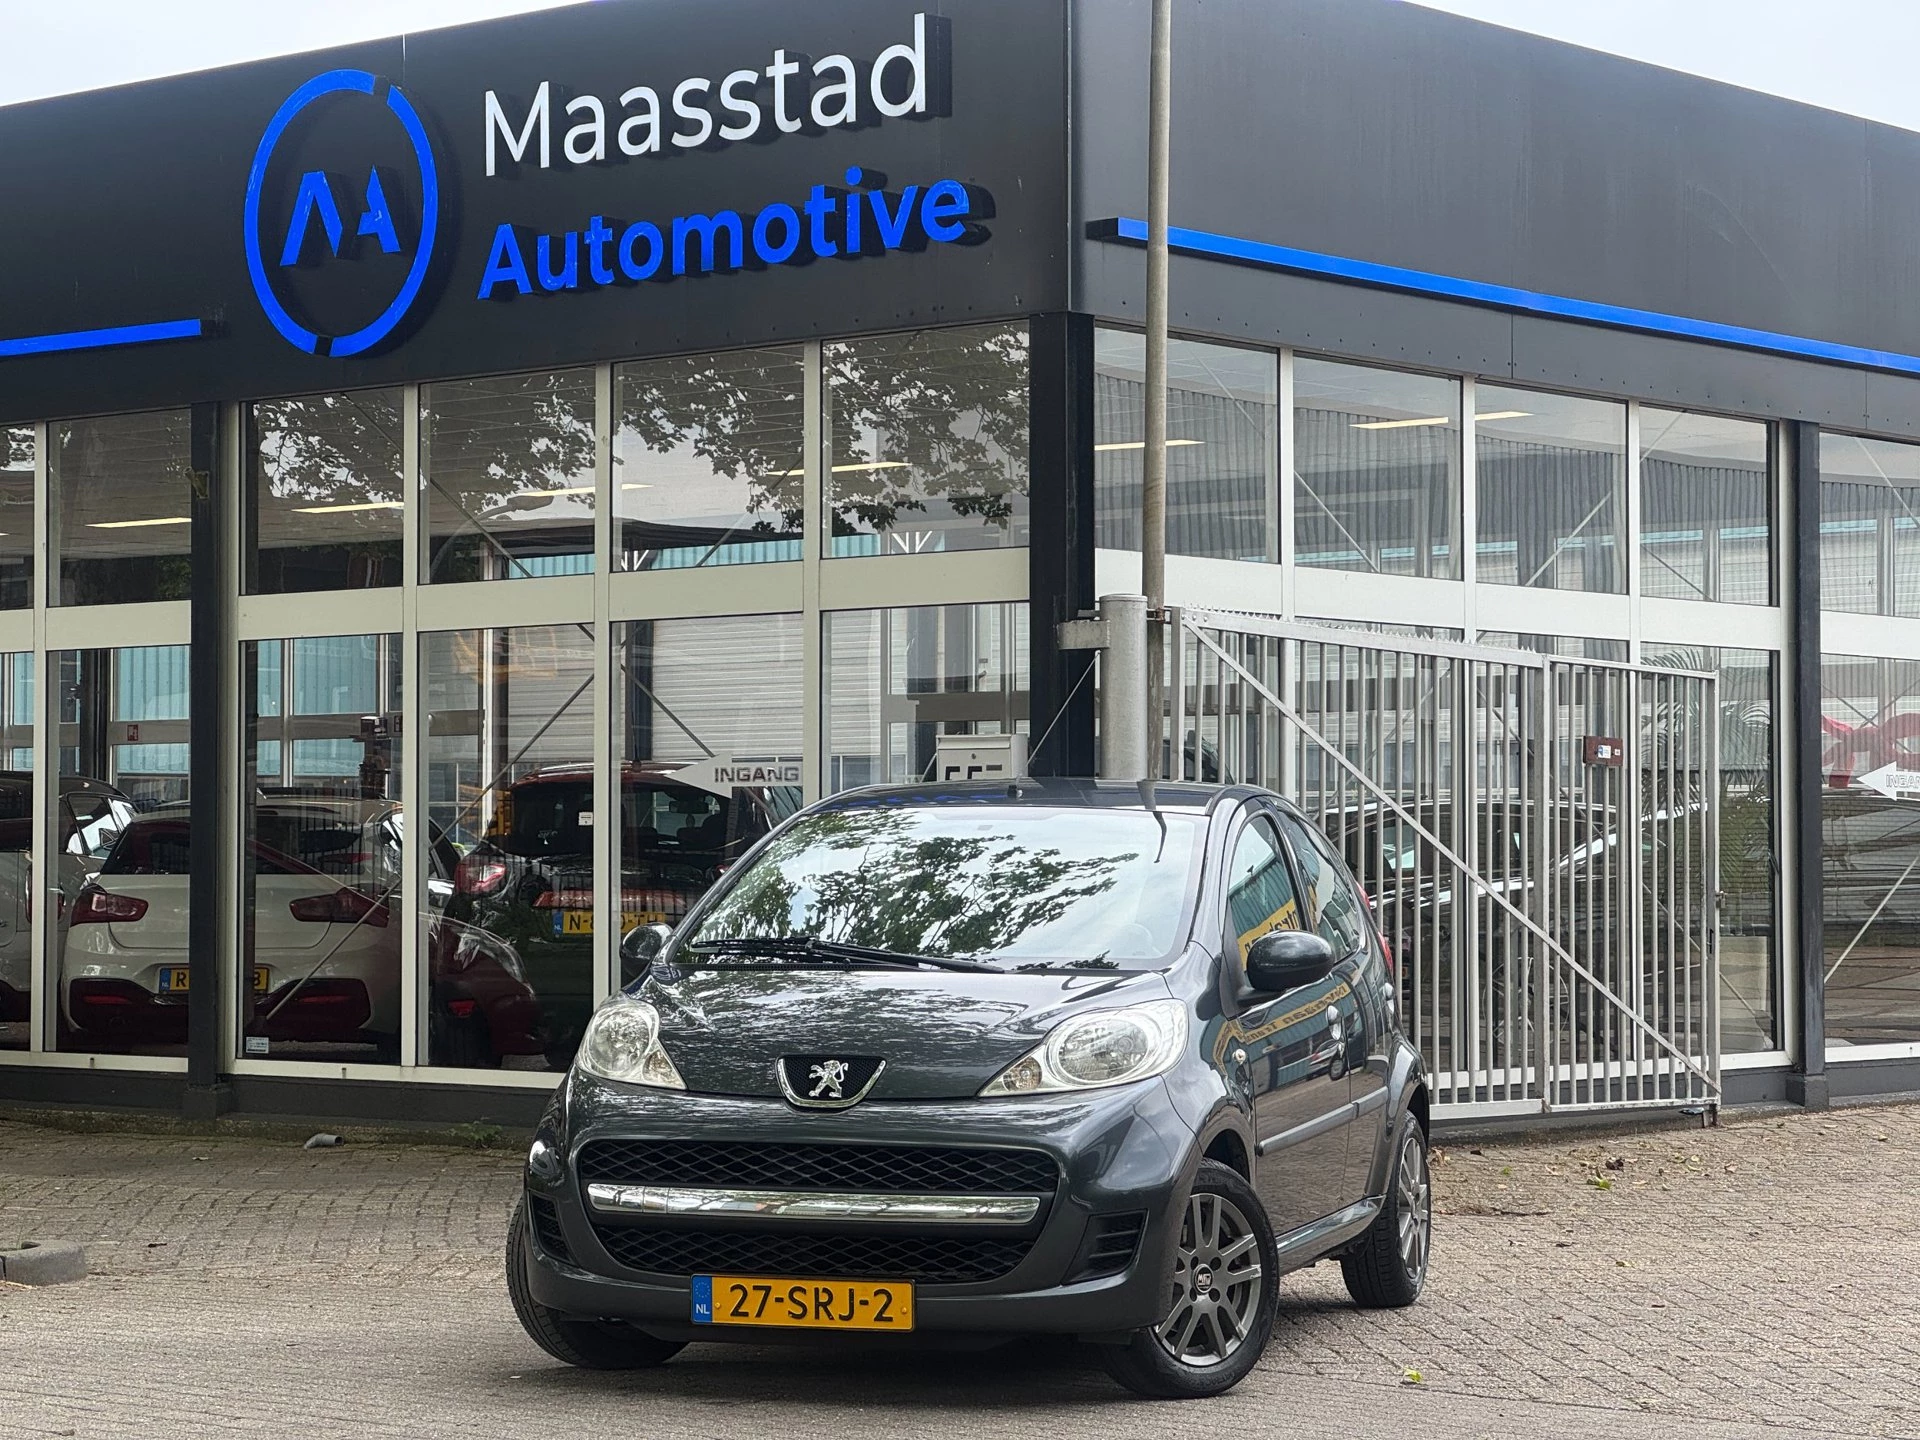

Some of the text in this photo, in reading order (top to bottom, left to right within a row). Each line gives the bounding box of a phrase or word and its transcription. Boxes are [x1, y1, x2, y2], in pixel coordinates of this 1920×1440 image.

[484, 12, 927, 177] Maasstad
[478, 166, 969, 301] Automotive
[714, 766, 800, 783] INGANG
[695, 1304, 710, 1315] NL
[729, 1283, 894, 1323] 27-SRJ-2
